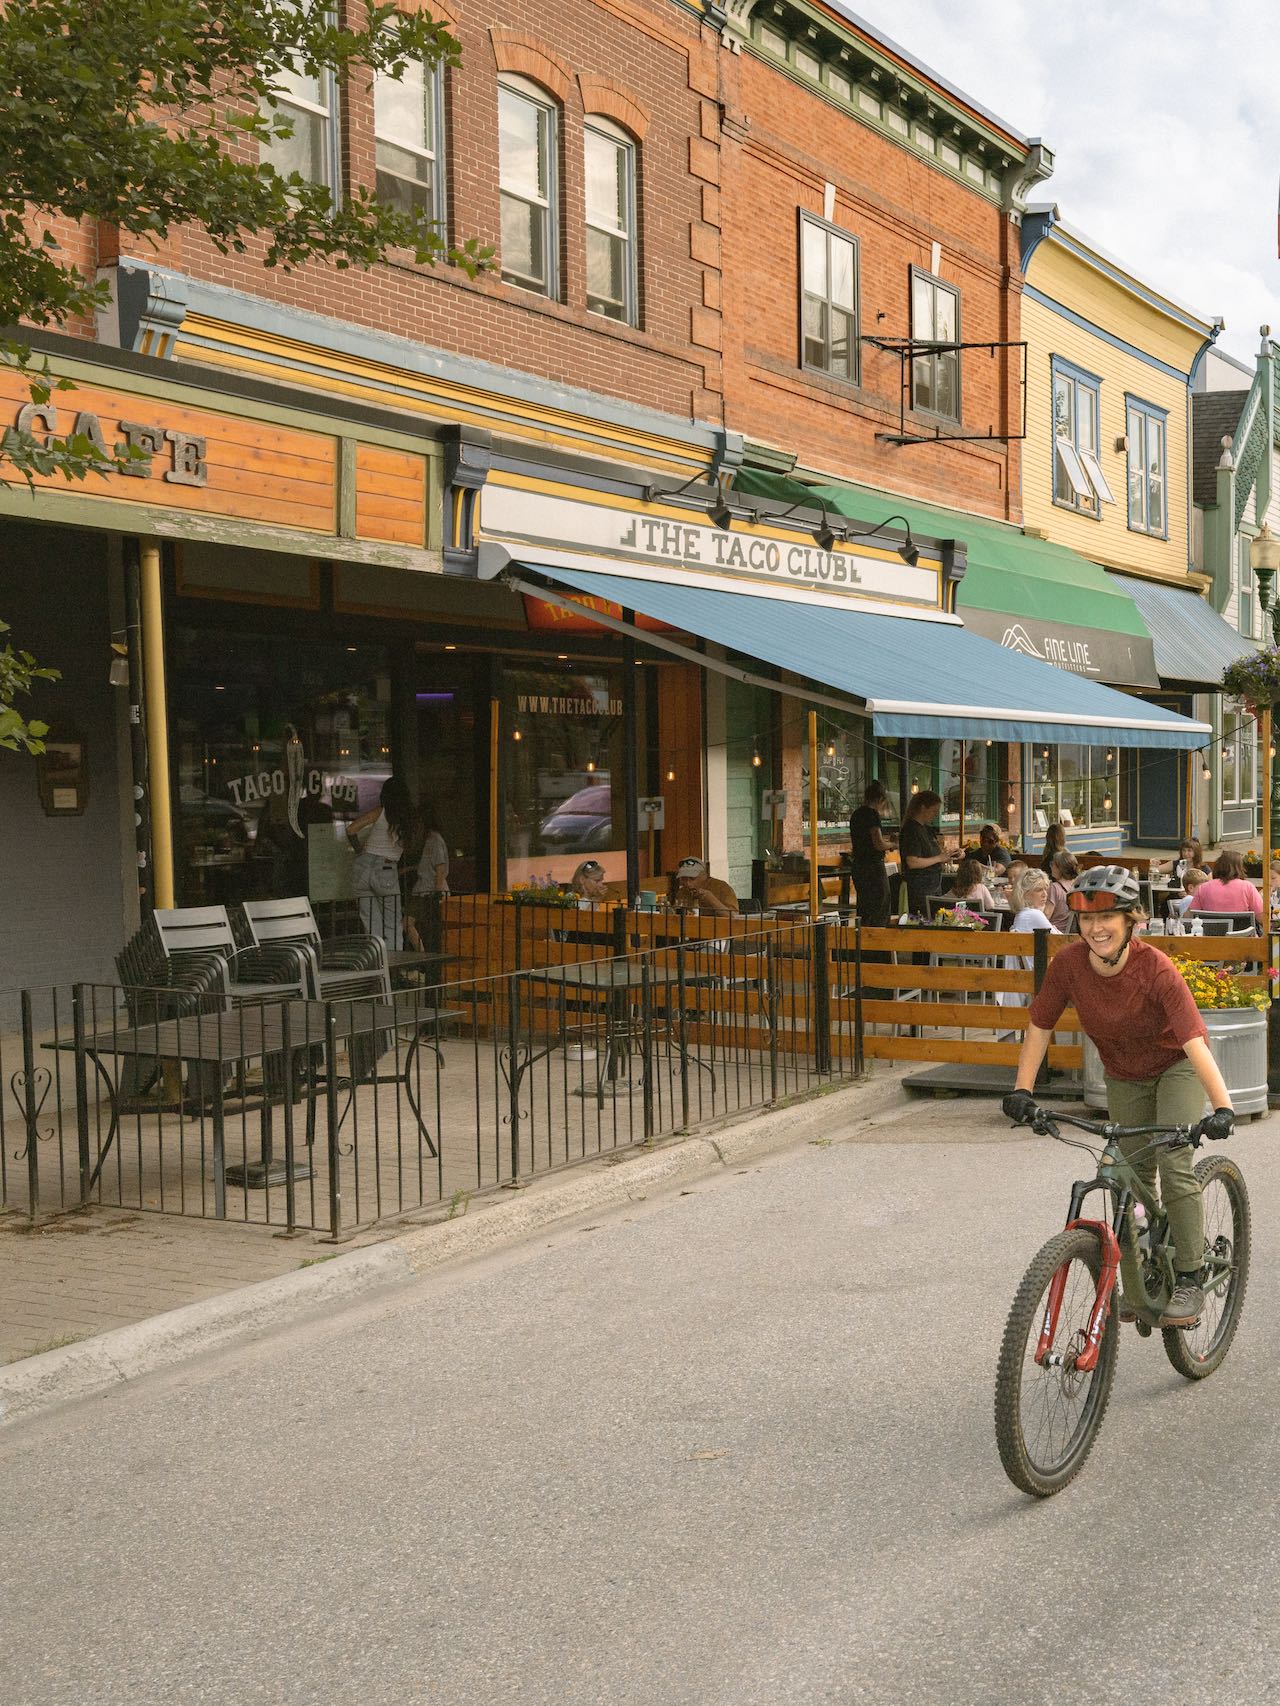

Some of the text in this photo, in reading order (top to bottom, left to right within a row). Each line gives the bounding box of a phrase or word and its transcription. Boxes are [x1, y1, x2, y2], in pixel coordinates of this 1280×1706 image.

[641, 518, 848, 583] THE TACO CLUB
[1044, 637, 1091, 665] FINE LINE
[227, 769, 359, 806] TACO CLUB
